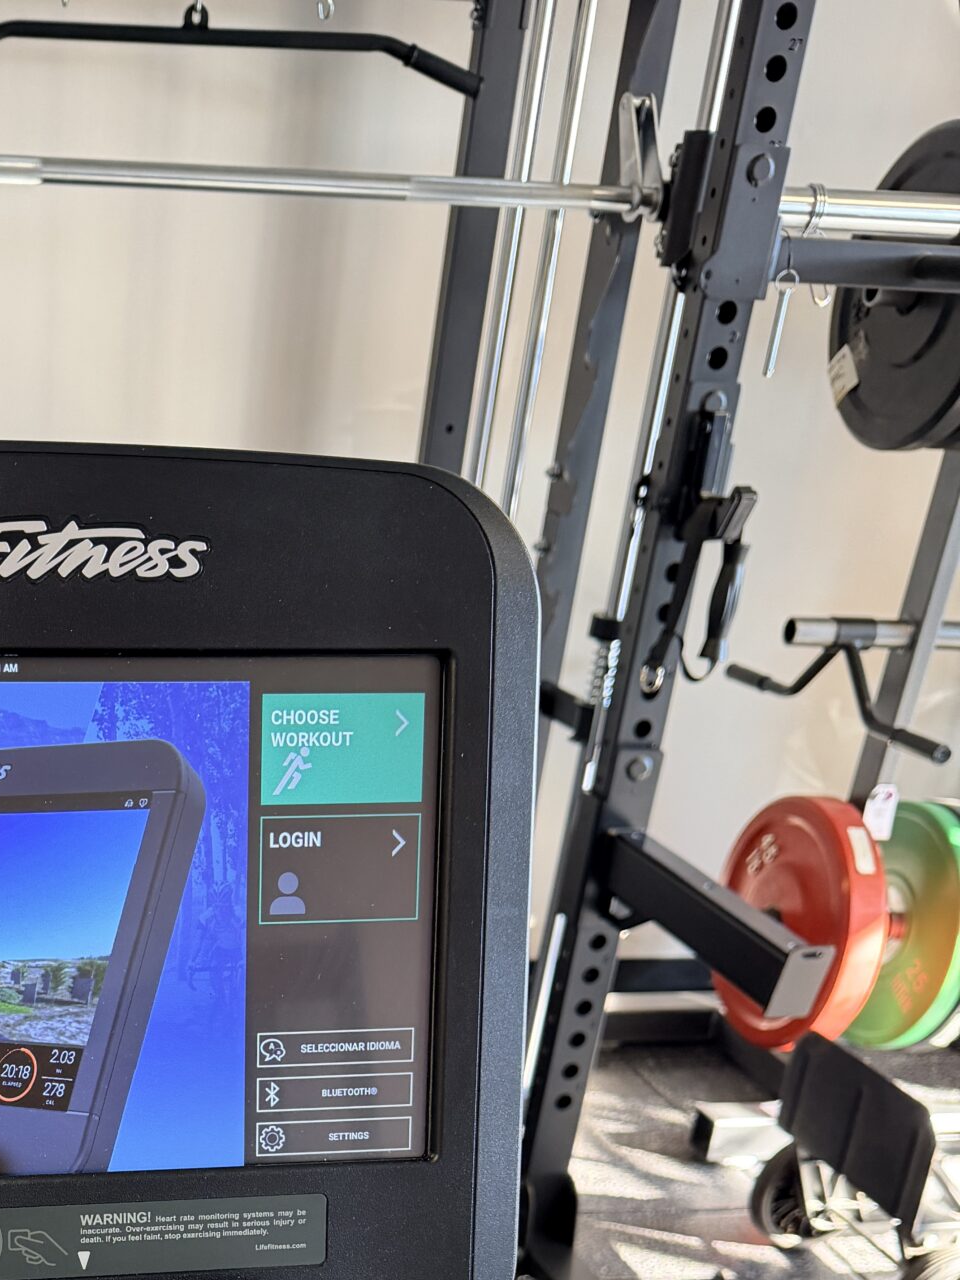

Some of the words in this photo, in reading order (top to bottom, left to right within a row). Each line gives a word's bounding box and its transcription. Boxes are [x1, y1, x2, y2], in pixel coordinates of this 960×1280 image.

[3, 663, 18, 672] AM
[271, 709, 340, 725] CHOOSE
[271, 731, 353, 747] WORKOUT
[269, 832, 322, 848] LOGIN
[300, 1042, 366, 1053] SELECCIONAR
[367, 1041, 400, 1051] IDIOMA
[49, 1049, 76, 1065] 2.03
[1, 1063, 31, 1079] 20:18
[43, 1082, 65, 1097] 278
[328, 1132, 369, 1141] SETTINGS
[80, 1211, 150, 1226] WARNING!
[155, 1214, 176, 1222] Heart
[179, 1213, 194, 1221] rate
[198, 1211, 239, 1222] monitoring
[242, 1210, 274, 1220] systems
[80, 1226, 121, 1234] inaccurate.
[125, 1223, 184, 1234] Over-exercising
[206, 1221, 228, 1229] result
[242, 1219, 270, 1227] serious
[273, 1218, 295, 1228] injury
[112, 1236, 126, 1244] you
[143, 1233, 162, 1242] faint,
[164, 1232, 181, 1241] stop
[182, 1231, 220, 1241] exercising
[222, 1229, 268, 1239] immediately.
[255, 1242, 306, 1251] Lifefitness.com
